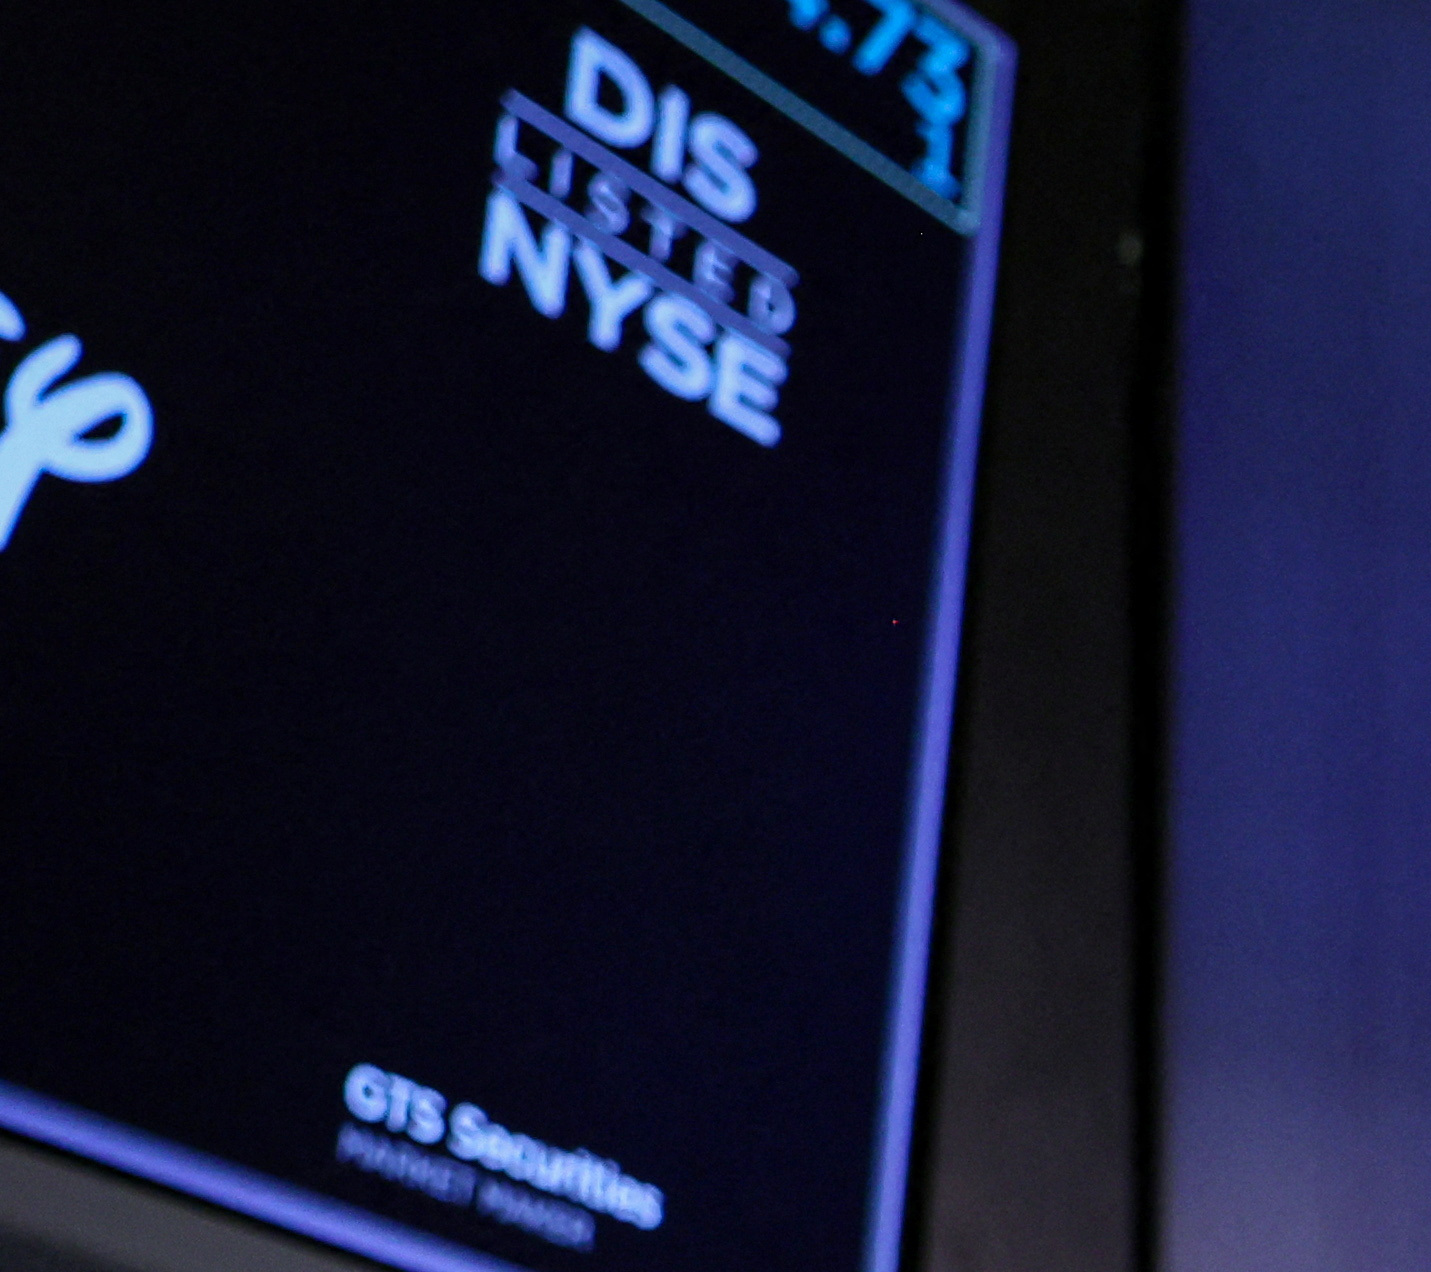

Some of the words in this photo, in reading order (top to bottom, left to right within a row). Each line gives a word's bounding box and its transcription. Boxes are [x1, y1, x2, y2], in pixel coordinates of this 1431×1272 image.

[494, 113, 797, 335] LISTED
[564, 26, 759, 223] DIS
[478, 192, 783, 449] NYSE
[344, 1062, 446, 1144] GTS
[447, 1101, 665, 1231] Securities
